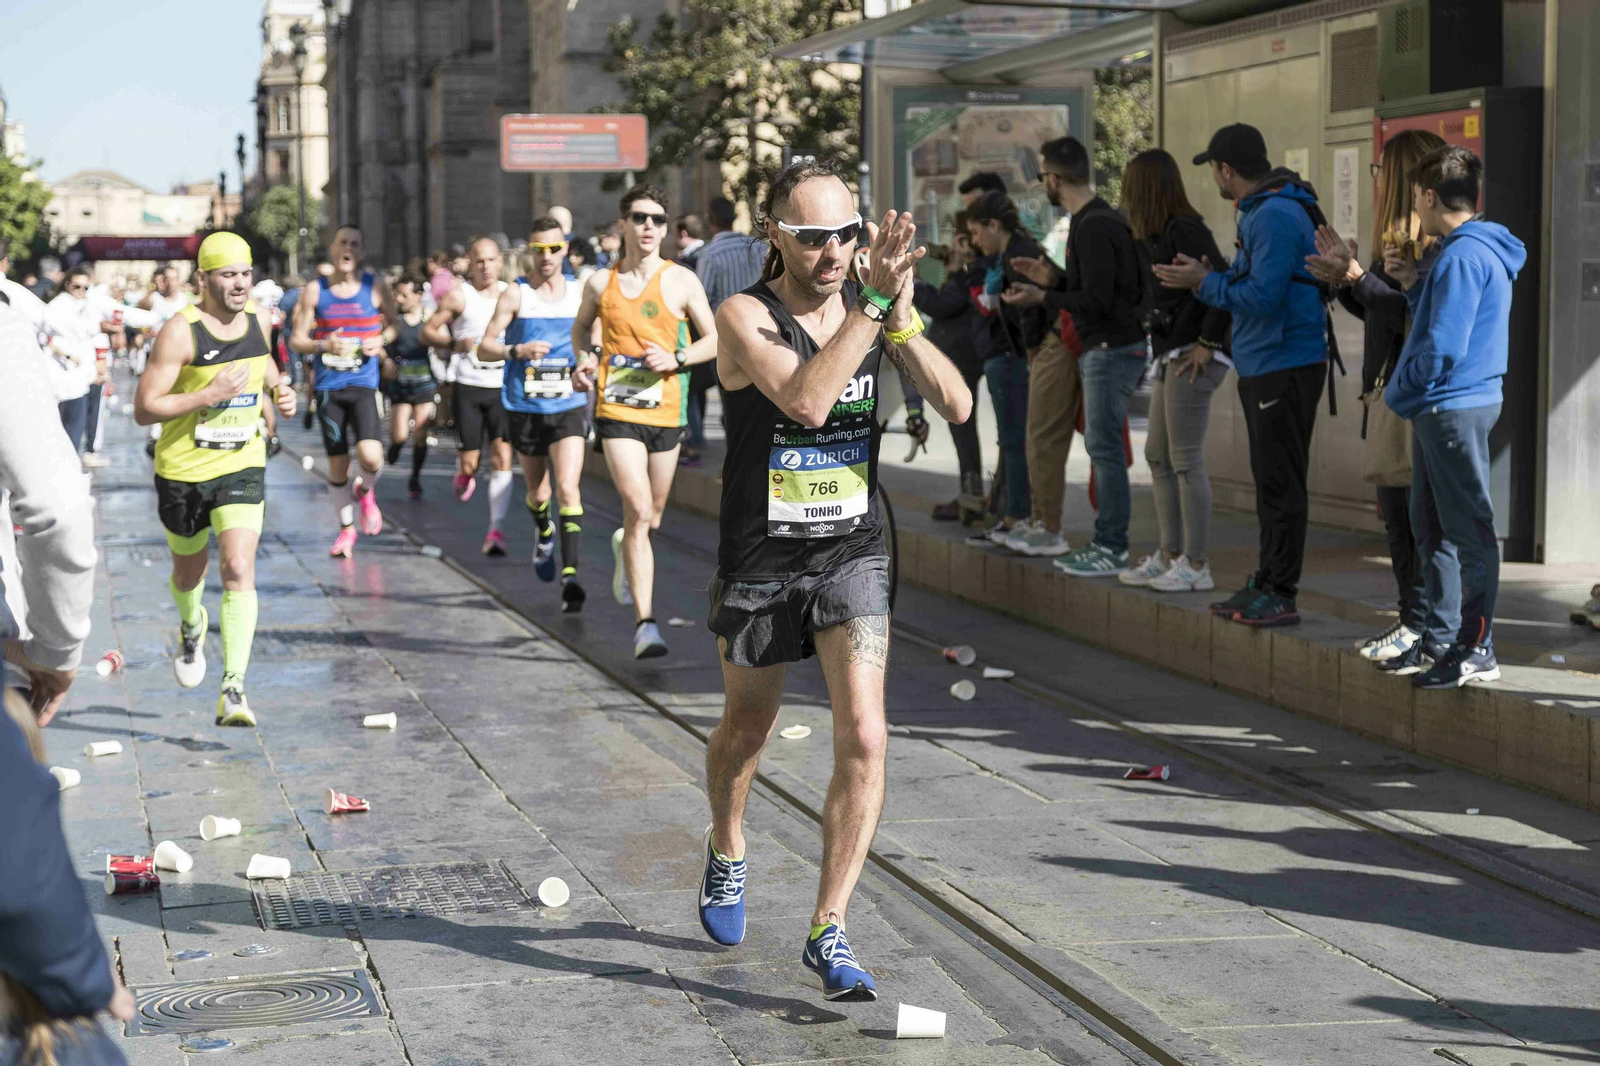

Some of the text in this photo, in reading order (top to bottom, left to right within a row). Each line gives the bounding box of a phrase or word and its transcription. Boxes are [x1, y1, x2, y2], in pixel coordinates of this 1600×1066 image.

[829, 397, 876, 418] NNERS
[773, 426, 871, 446] BeUrbanRunning.com
[805, 447, 860, 466] ZURICH
[808, 480, 839, 497] 766
[803, 504, 842, 519] TONHO
